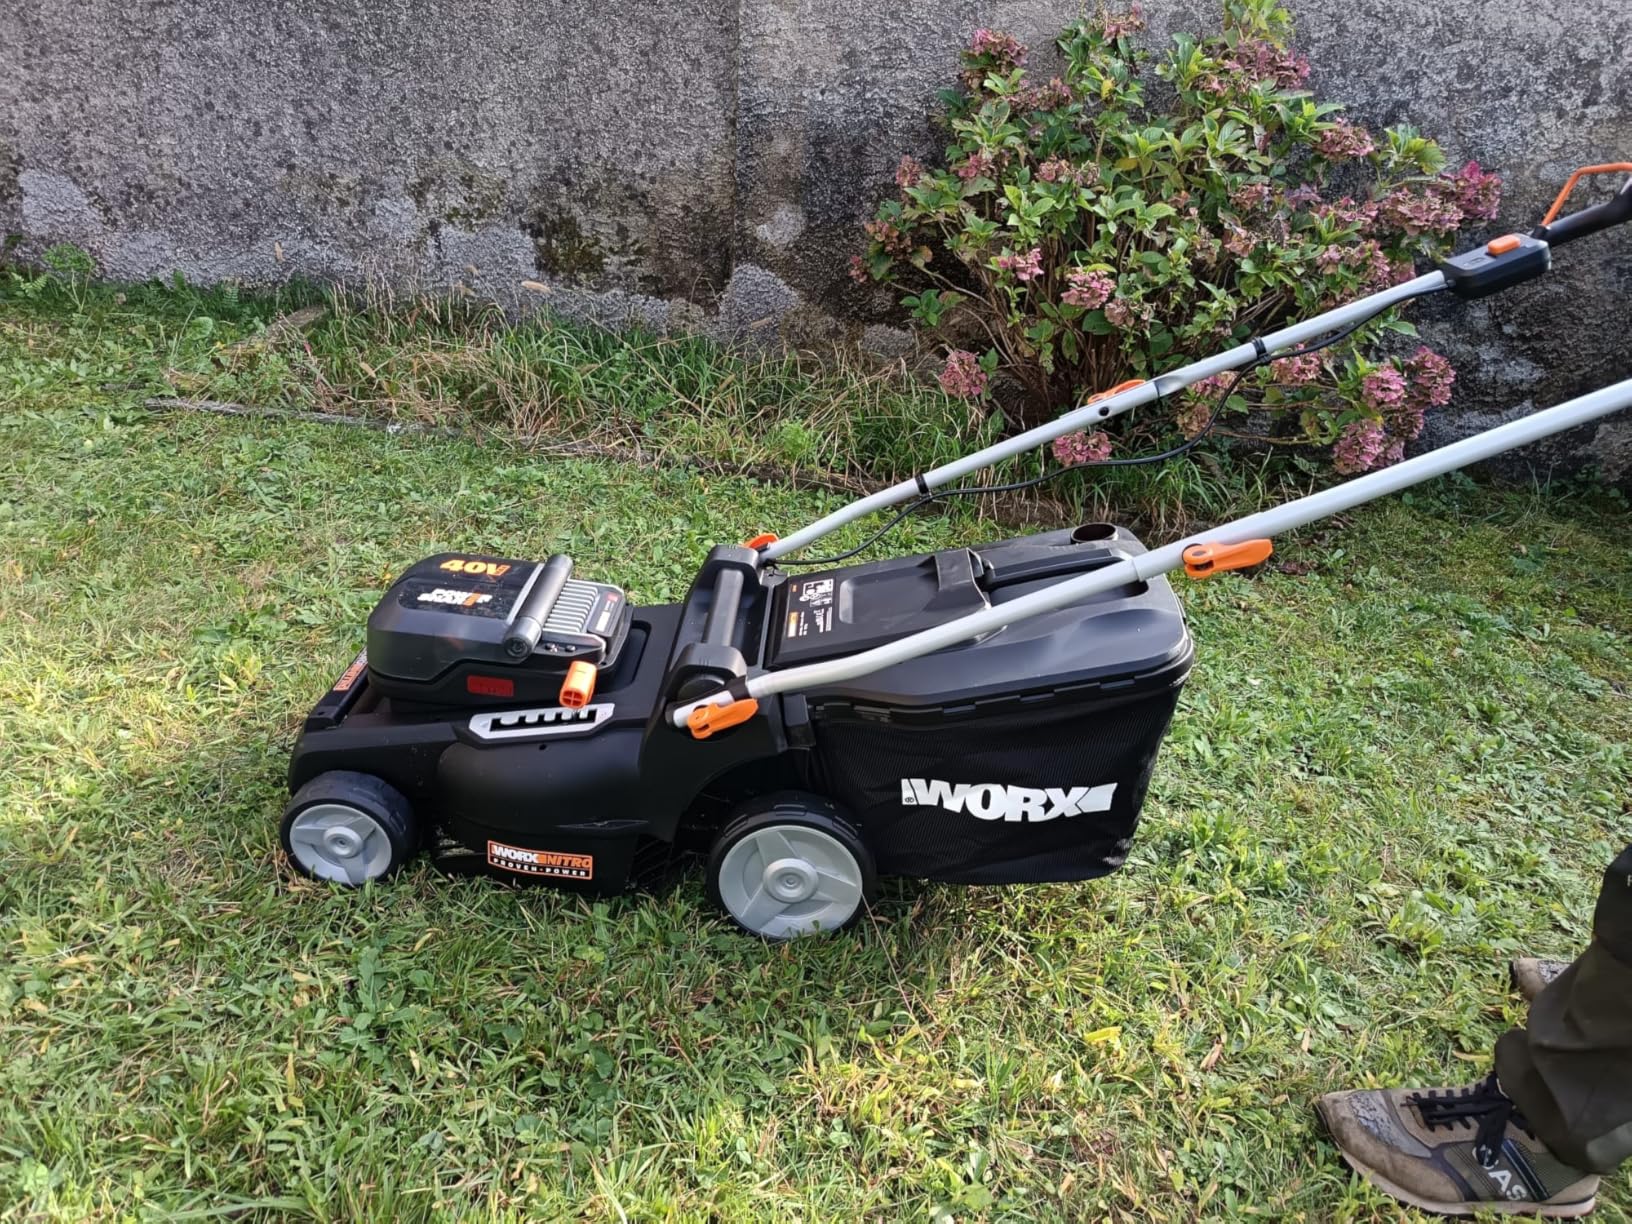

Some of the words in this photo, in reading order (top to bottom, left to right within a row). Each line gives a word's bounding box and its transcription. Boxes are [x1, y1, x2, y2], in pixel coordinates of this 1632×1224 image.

[440, 560, 511, 577] 40V
[904, 778, 1091, 822] WORX
[493, 858, 537, 871] PROVEN
[546, 868, 585, 876] POWER
[547, 855, 591, 867] NITRO
